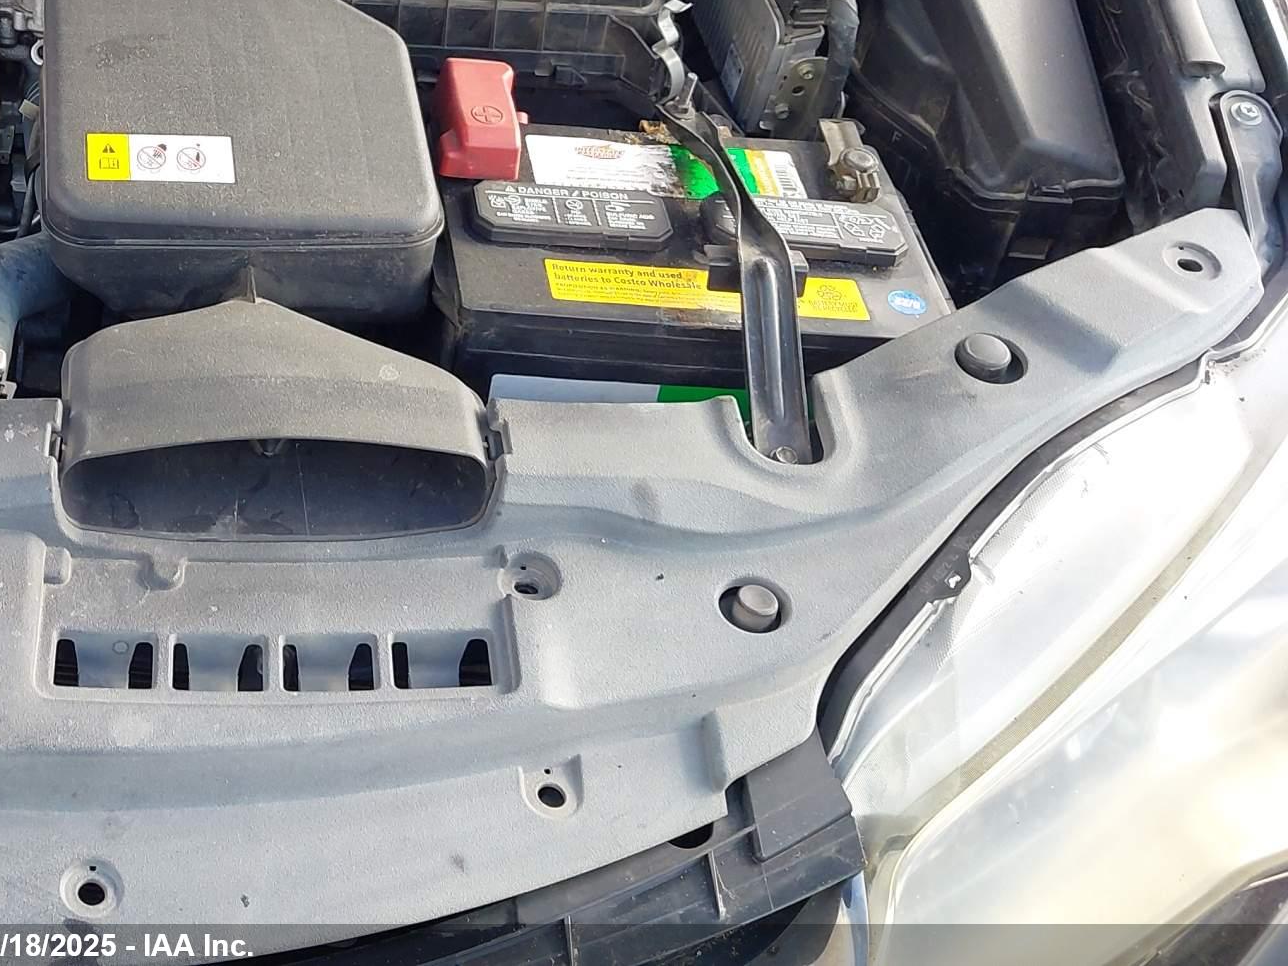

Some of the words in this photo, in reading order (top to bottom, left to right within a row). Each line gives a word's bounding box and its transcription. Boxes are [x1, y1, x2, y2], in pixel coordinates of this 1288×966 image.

[517, 186, 569, 196] DANGER
[581, 190, 629, 200] POISON
[552, 263, 586, 273] Return
[588, 266, 634, 277] warranty
[637, 269, 656, 278] and
[658, 272, 683, 280] used
[554, 272, 599, 283] batteries
[600, 276, 612, 284] to
[614, 277, 646, 286] Costco
[648, 279, 702, 290] Wholesale
